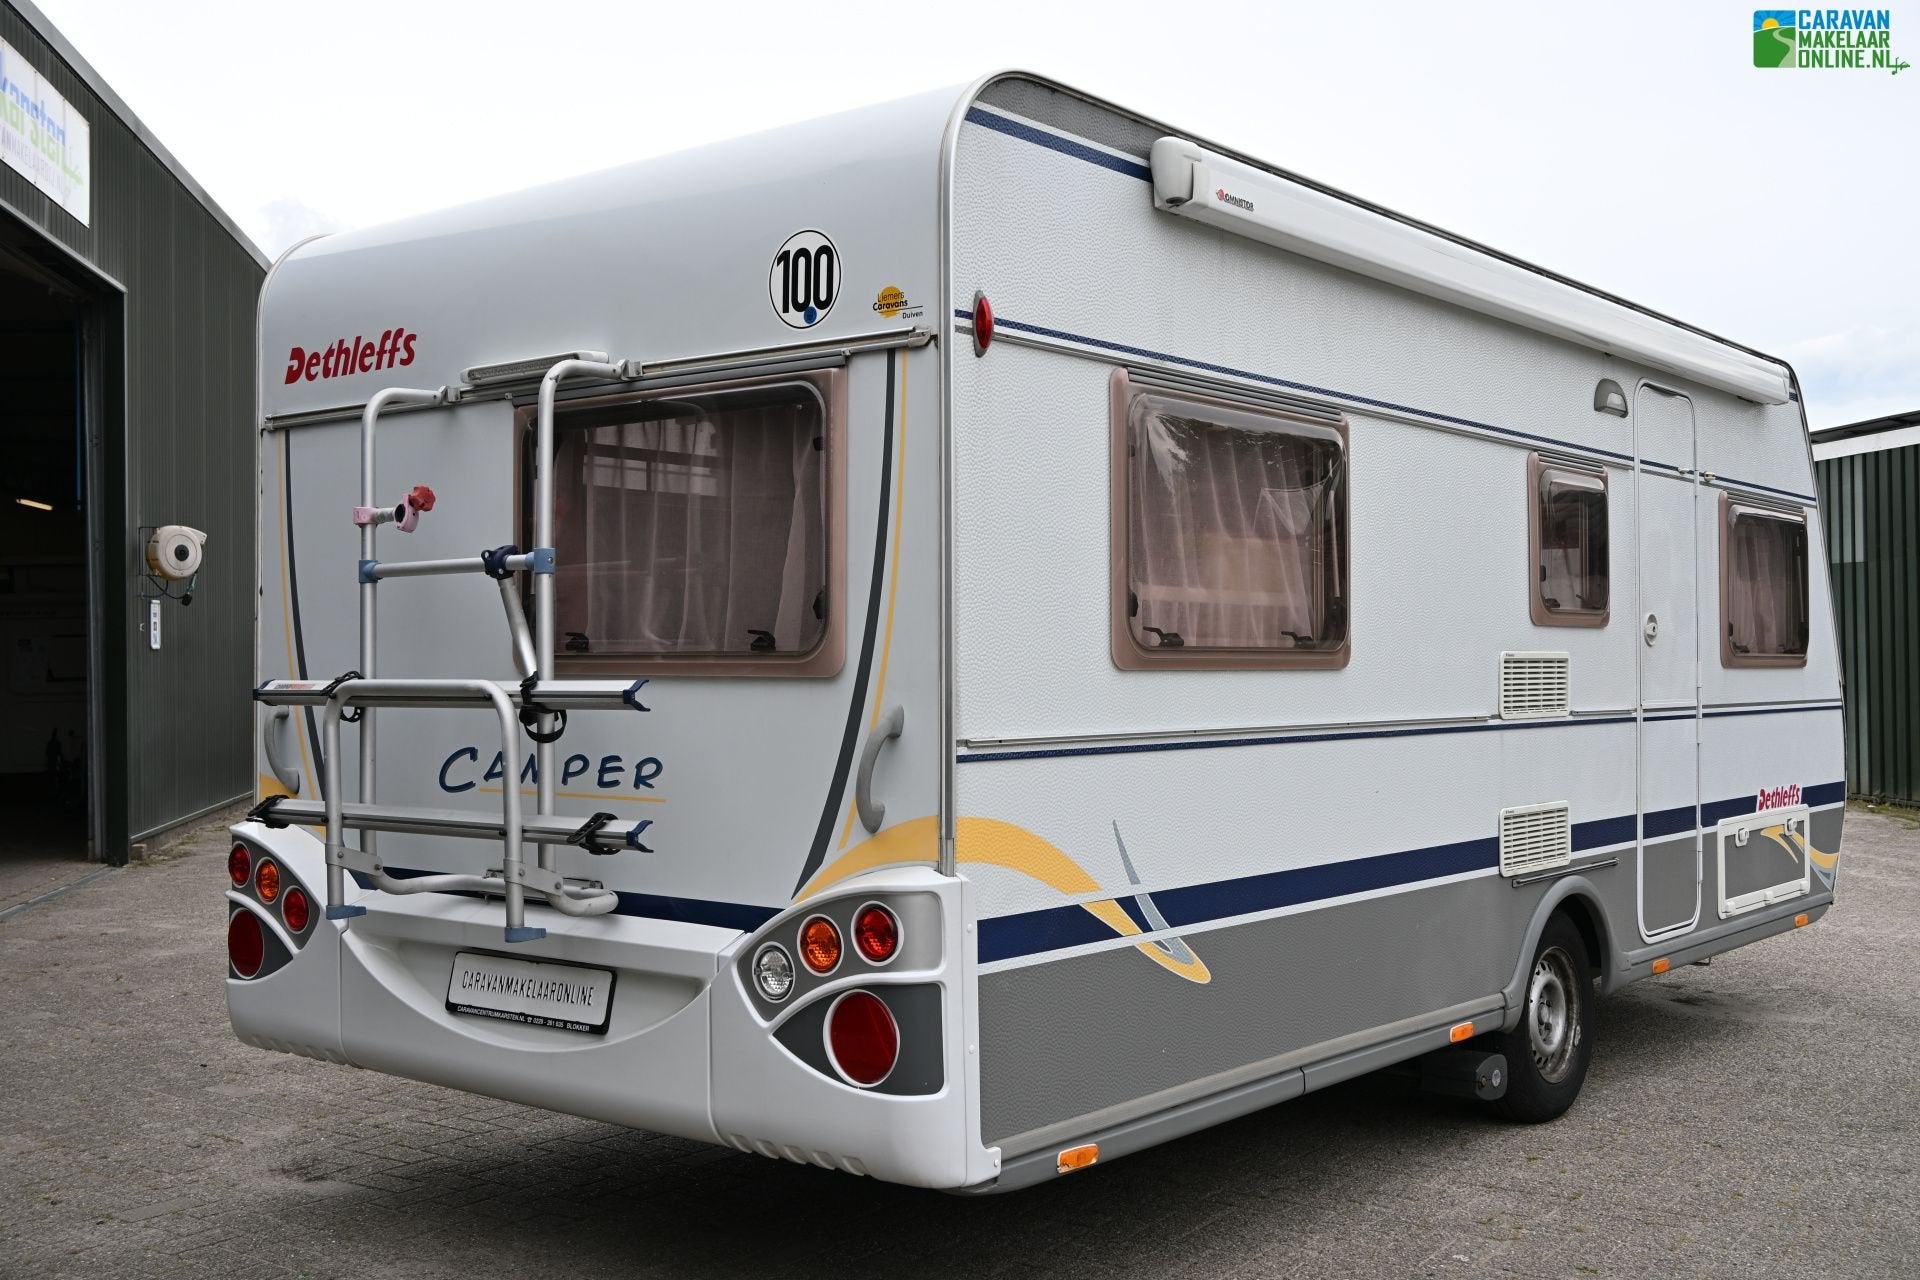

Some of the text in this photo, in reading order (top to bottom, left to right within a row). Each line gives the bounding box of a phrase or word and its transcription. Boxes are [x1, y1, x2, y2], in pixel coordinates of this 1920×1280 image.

[777, 245, 834, 313] 100
[873, 300, 908, 311] Caravans
[878, 291, 905, 303] Liemers
[902, 311, 923, 319] Duiven
[285, 328, 417, 384] Dethleffs
[1758, 784, 1801, 811] Dethleffs
[462, 970, 595, 1006] CARAVANMAKELAARONLINE
[567, 1022, 590, 1031] BLOKKER
